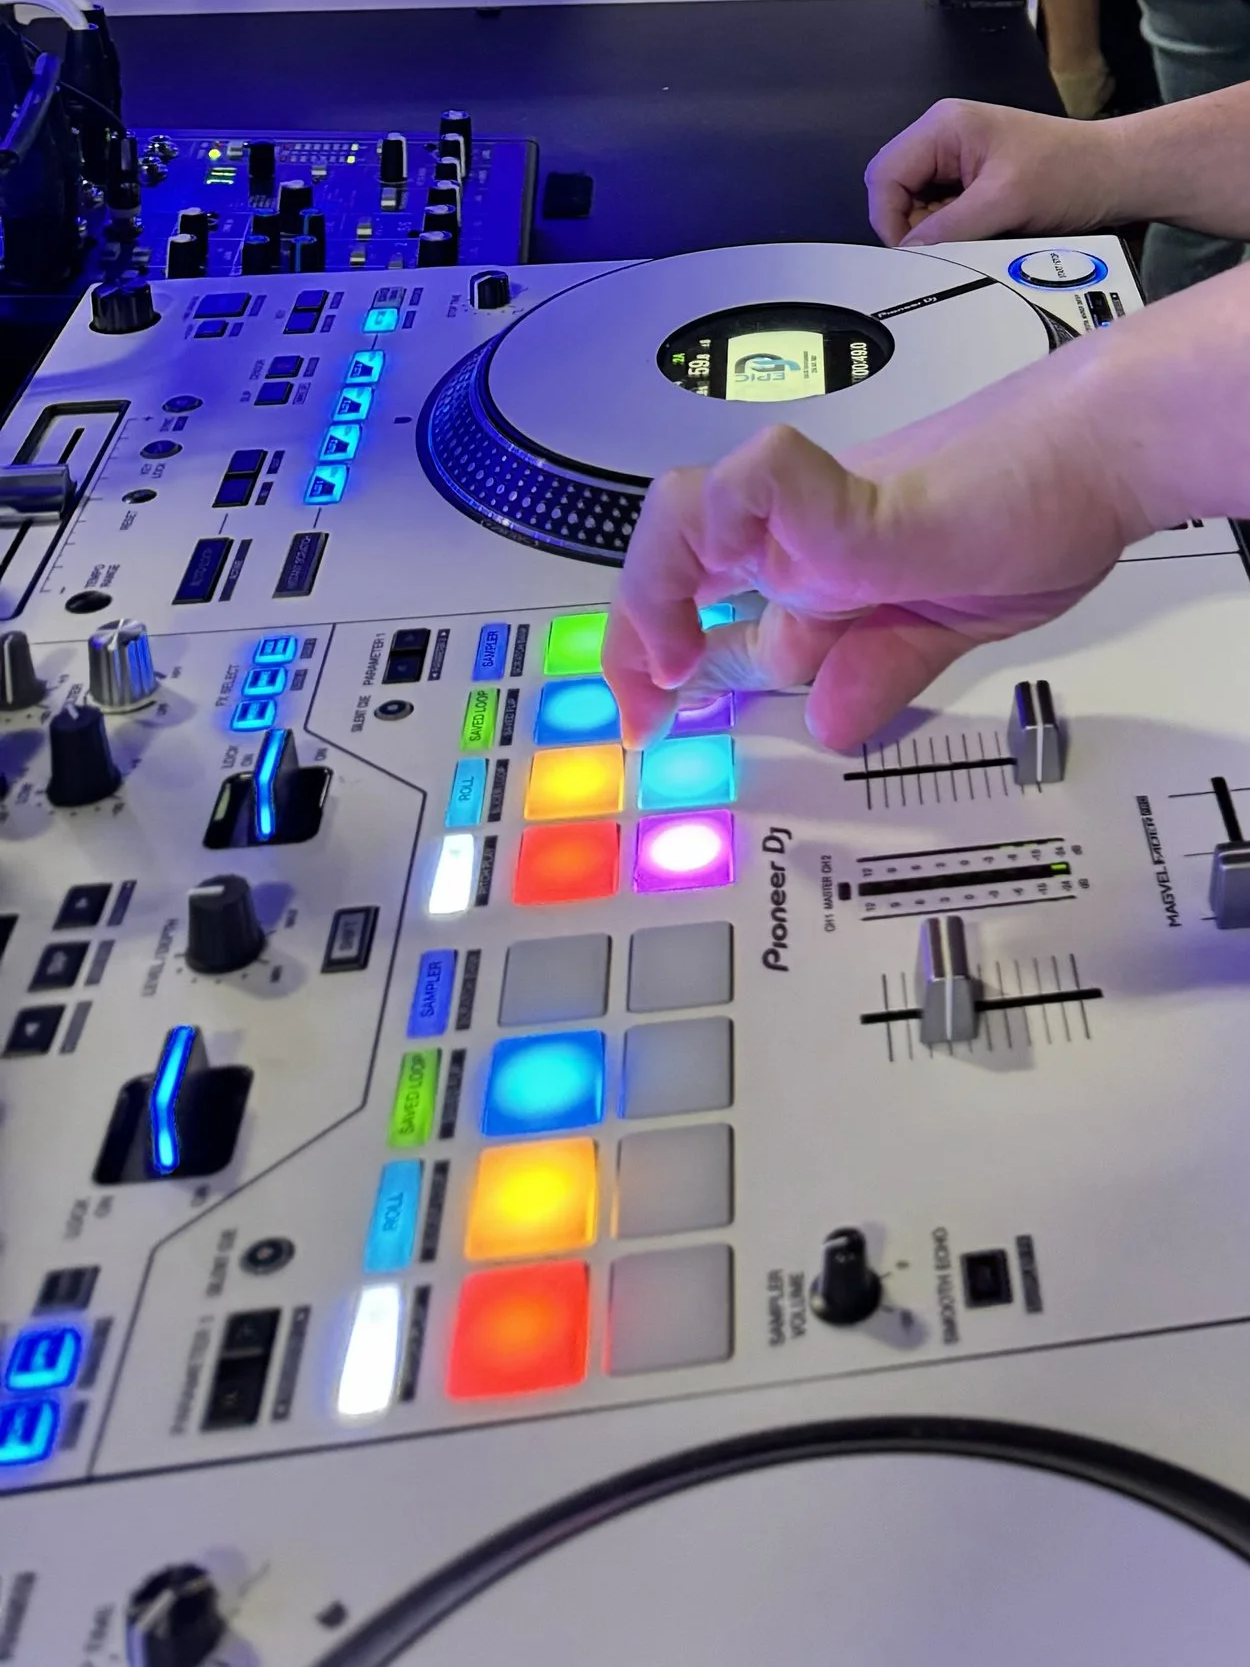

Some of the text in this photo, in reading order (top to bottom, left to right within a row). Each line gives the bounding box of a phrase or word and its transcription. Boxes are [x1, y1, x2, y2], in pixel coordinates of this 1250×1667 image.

[734, 370, 786, 383] EPIC
[481, 630, 499, 668] SAMPLER
[469, 689, 489, 742] SAVED LOOP
[458, 776, 475, 802] ROLL
[761, 860, 790, 973] Pioneer
[822, 876, 834, 910] MASTER
[1156, 865, 1182, 928] MAGVEL
[419, 960, 443, 1018] SAMPLER
[400, 1054, 426, 1135] SAVED LOOP
[383, 1191, 404, 1233] ROLL
